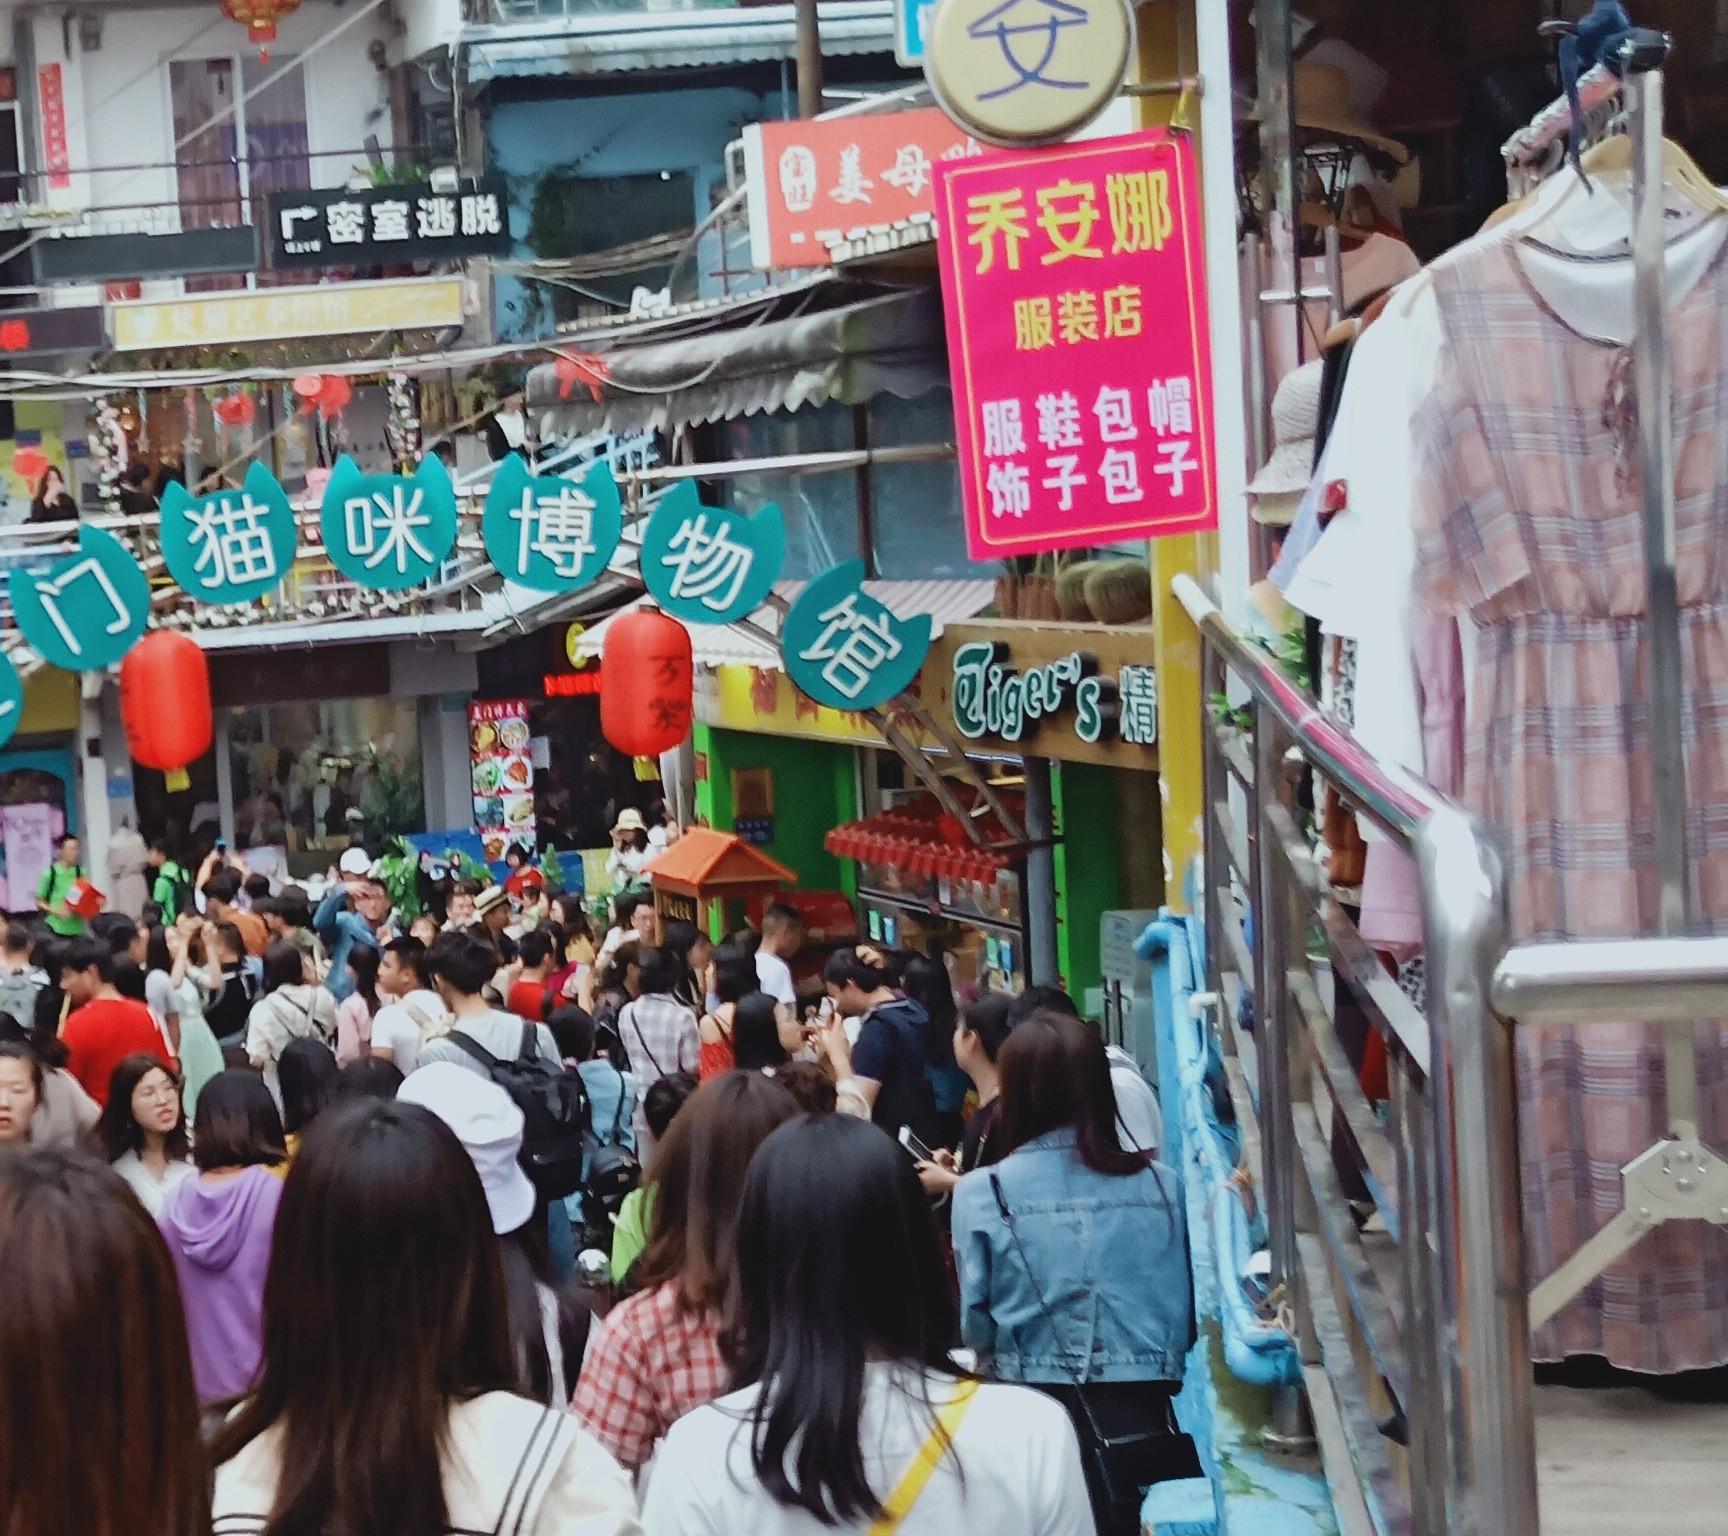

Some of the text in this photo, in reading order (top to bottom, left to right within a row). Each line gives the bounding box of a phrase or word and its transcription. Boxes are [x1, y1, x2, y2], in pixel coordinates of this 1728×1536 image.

[326, 193, 502, 244] 密室逃脱
[967, 169, 1173, 276] 乔安娜
[1013, 284, 1144, 352] 服装店
